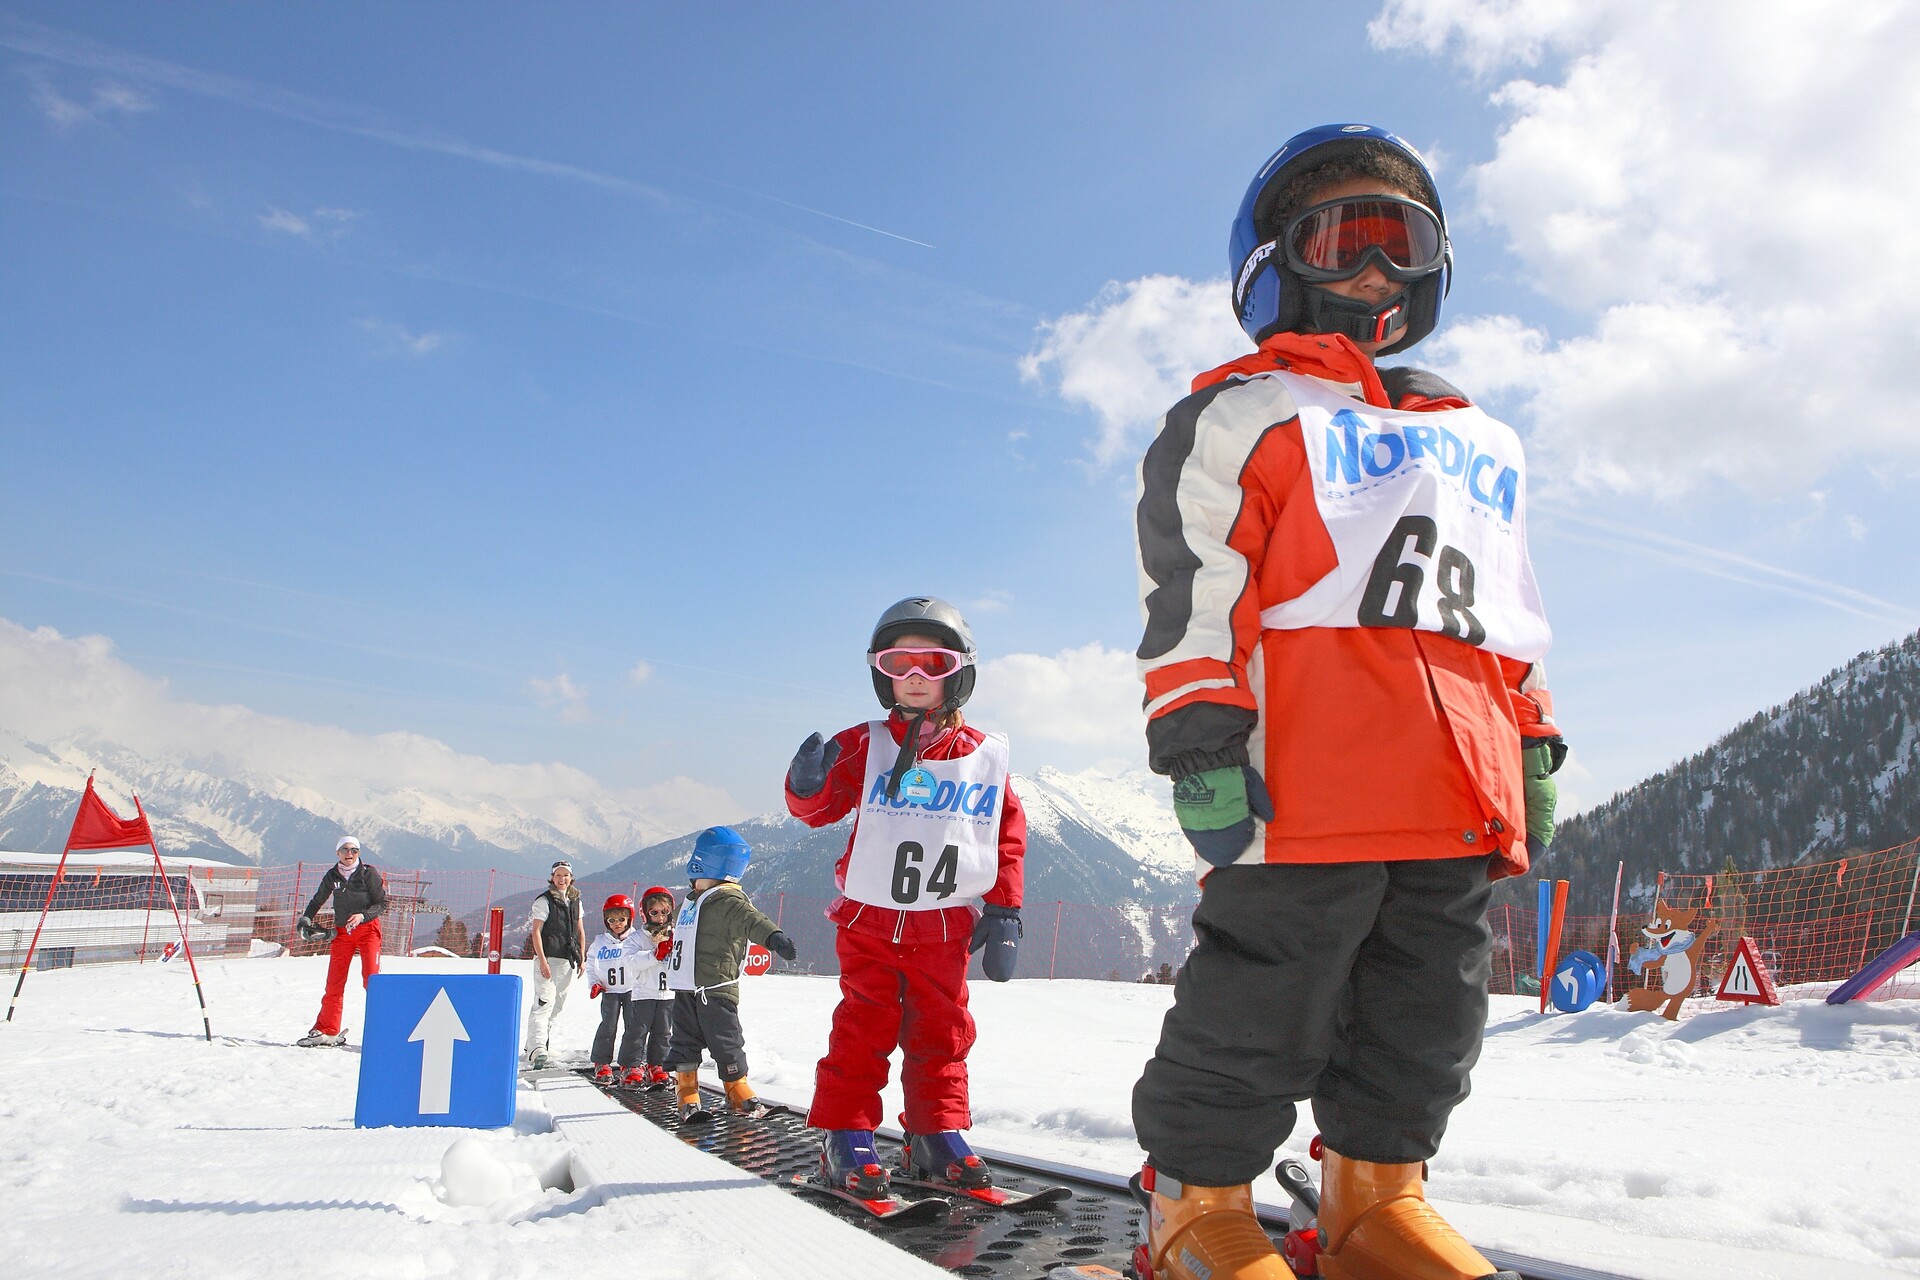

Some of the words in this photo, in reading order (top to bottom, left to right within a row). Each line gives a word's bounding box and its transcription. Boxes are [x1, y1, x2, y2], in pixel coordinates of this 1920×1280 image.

[1326, 408, 1519, 524] NORDICA
[1327, 463, 1511, 535] SPORTEM
[1357, 515, 1487, 646] 68
[866, 807, 991, 826] SPORTSYSTEM
[891, 840, 959, 904] 64
[597, 945, 623, 960] NORD
[607, 966, 625, 986] 61
[667, 940, 683, 971] 3
